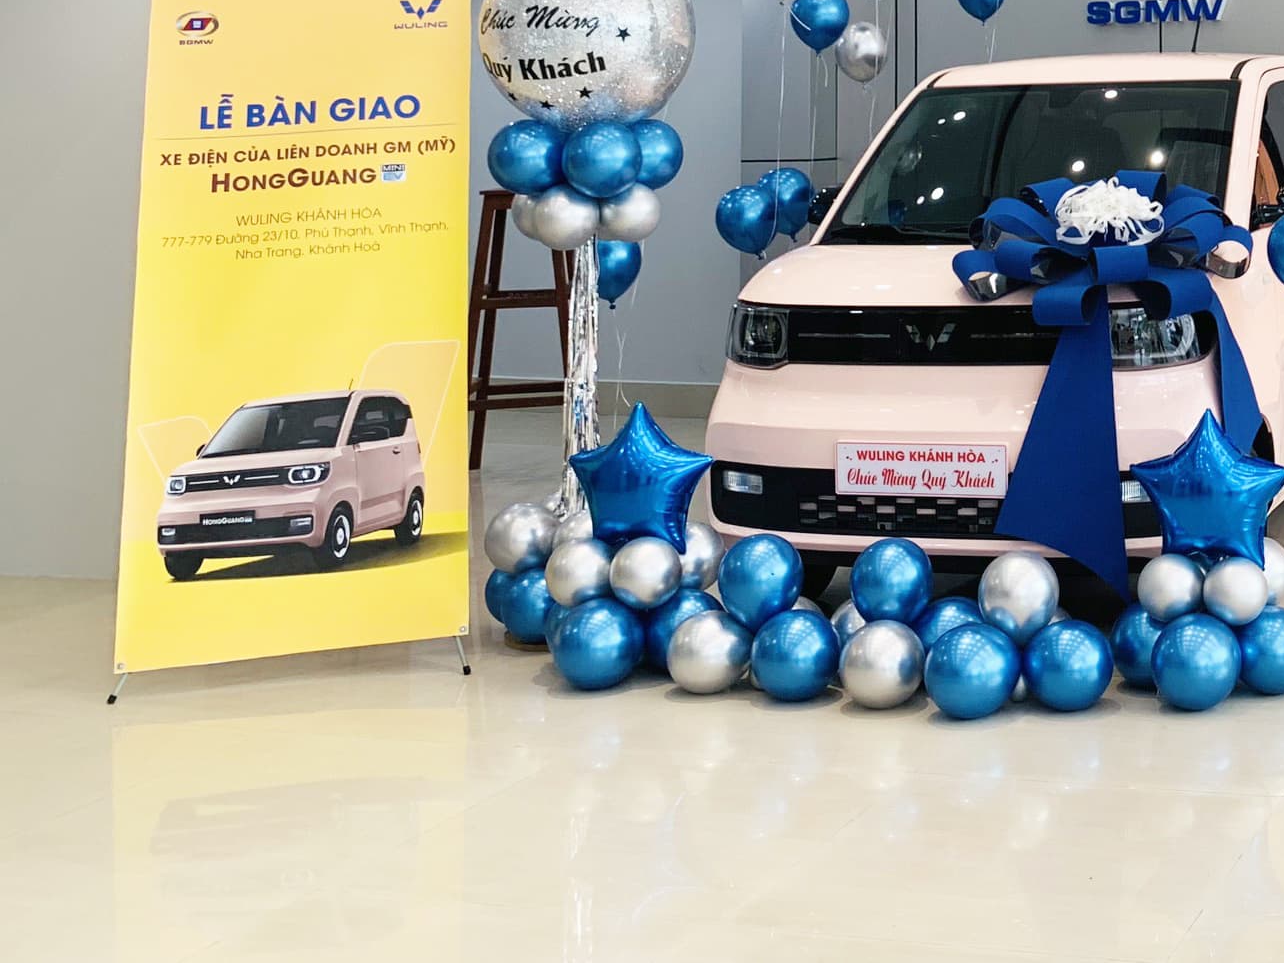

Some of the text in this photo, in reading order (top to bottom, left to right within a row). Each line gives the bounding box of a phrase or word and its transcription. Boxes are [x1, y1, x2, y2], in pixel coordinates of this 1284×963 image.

[394, 21, 448, 30] WULING
[480, 4, 600, 37] Chúc Mừng
[482, 51, 607, 82] Quý Khách
[200, 94, 421, 129] LỄ BÀN GIAO
[160, 135, 456, 168] XE ĐIỆN CỦA LIÊN DOANH GM (MỸ)
[236, 206, 382, 226] WULING KHÁNH HÒA
[161, 235, 212, 248] 777-779
[215, 231, 259, 247] Đường
[235, 248, 262, 261] Nha
[309, 242, 350, 255] Khánh
[856, 448, 986, 463] WULING KHÁNH HÒA
[847, 468, 996, 490] Chúc Mừng Quý Khách
